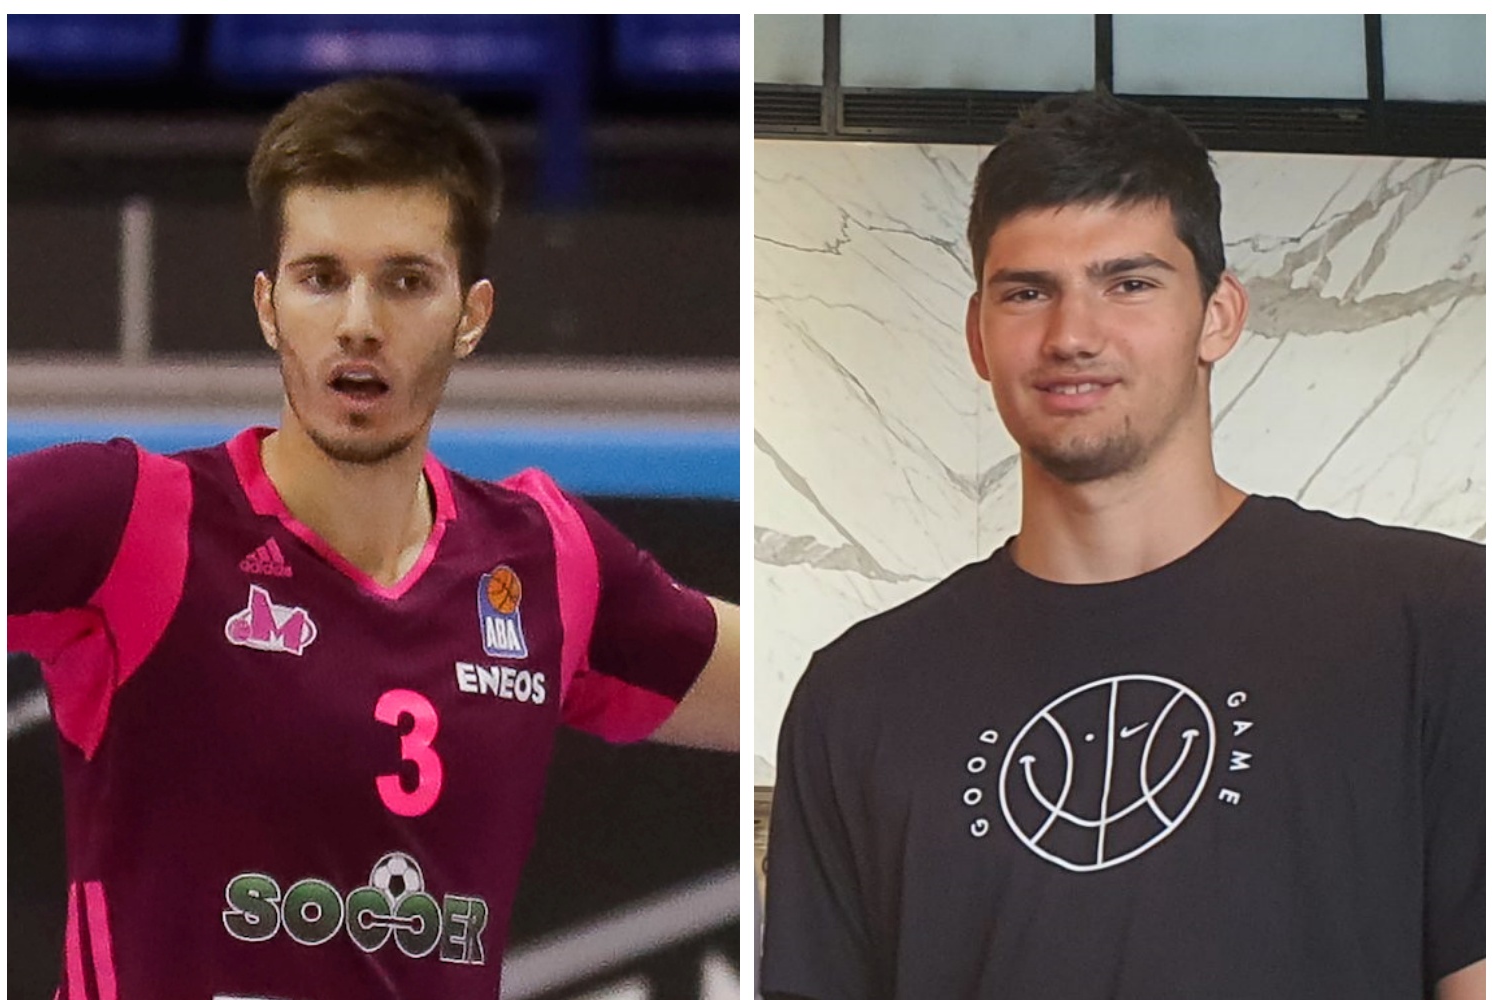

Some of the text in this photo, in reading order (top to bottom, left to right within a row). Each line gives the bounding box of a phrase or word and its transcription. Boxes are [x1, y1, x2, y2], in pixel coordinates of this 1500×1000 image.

[455, 661, 547, 705] ENEOS
[485, 616, 521, 651] ABA
[374, 689, 443, 817] 3
[963, 729, 999, 838] GOOD
[1219, 691, 1254, 806] GAME
[223, 873, 490, 966] SOCCER
